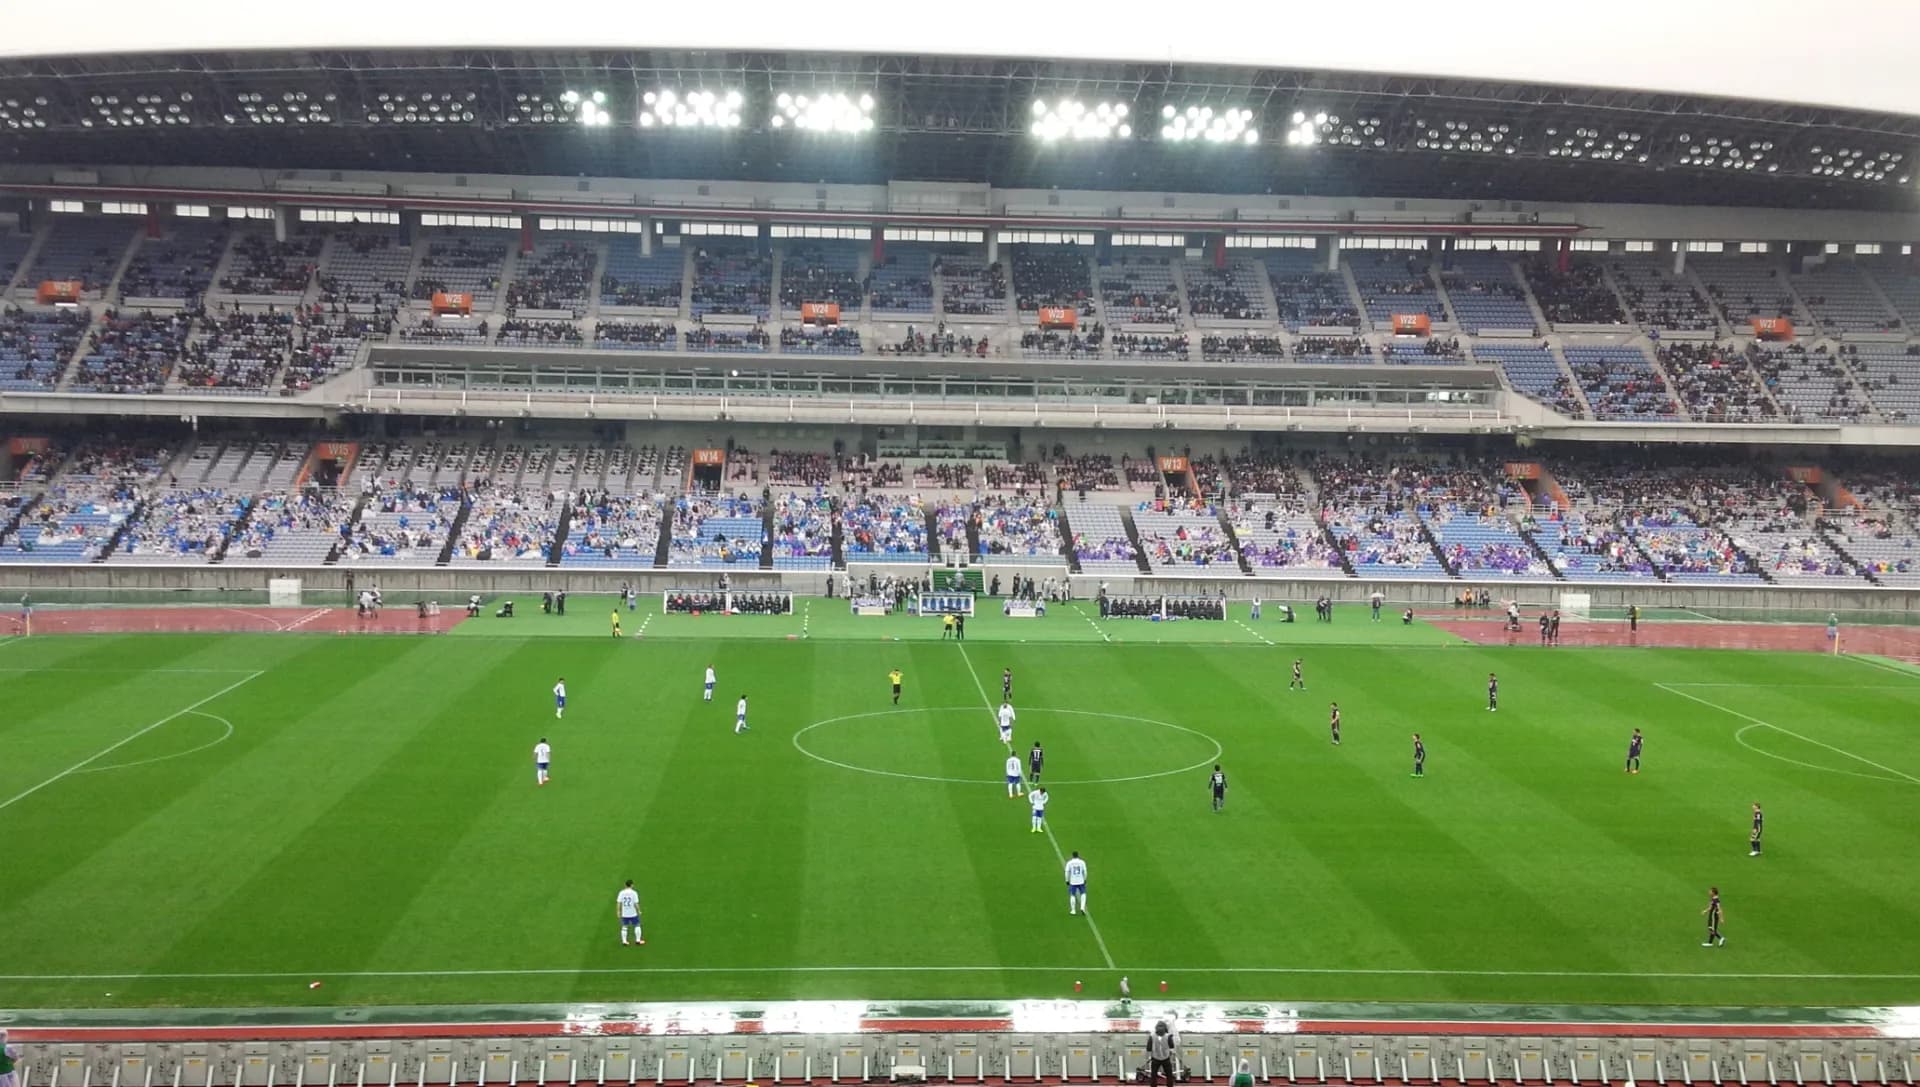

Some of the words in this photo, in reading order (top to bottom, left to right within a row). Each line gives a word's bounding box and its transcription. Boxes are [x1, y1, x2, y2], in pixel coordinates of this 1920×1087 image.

[811, 303, 829, 314] W24
[1400, 315, 1417, 325] W22
[1760, 319, 1776, 329] W21
[328, 443, 349, 455] W15
[699, 451, 718, 462] W14
[1162, 458, 1182, 470] W13
[623, 896, 633, 907] 22
